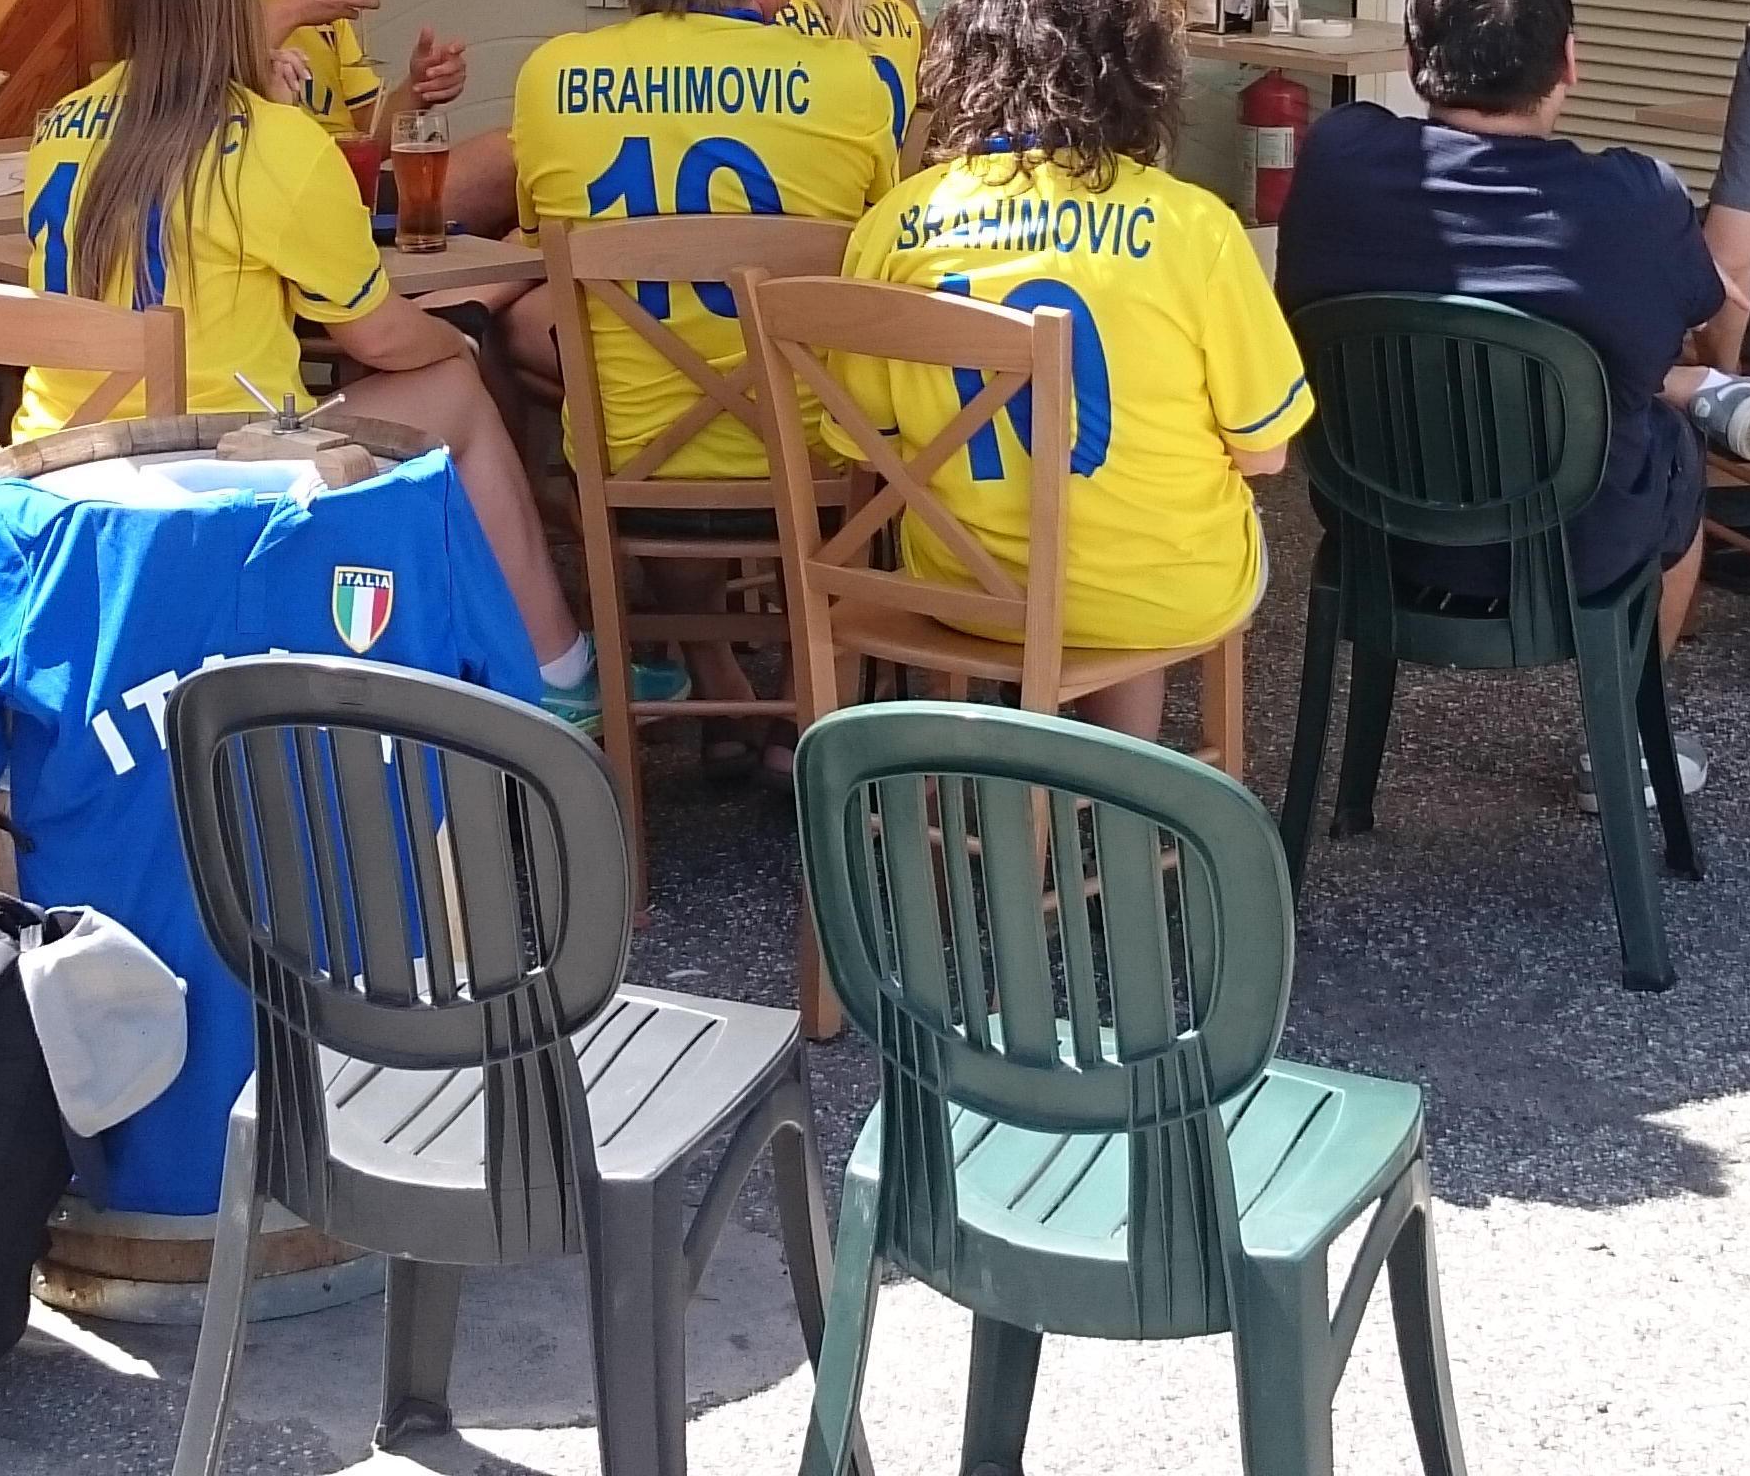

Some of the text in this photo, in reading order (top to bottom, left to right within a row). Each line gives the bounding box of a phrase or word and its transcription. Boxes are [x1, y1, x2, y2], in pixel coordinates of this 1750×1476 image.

[557, 61, 811, 116] IBRAHIMOVIĆ
[586, 136, 784, 321] 10
[337, 571, 391, 590] ITALIA
